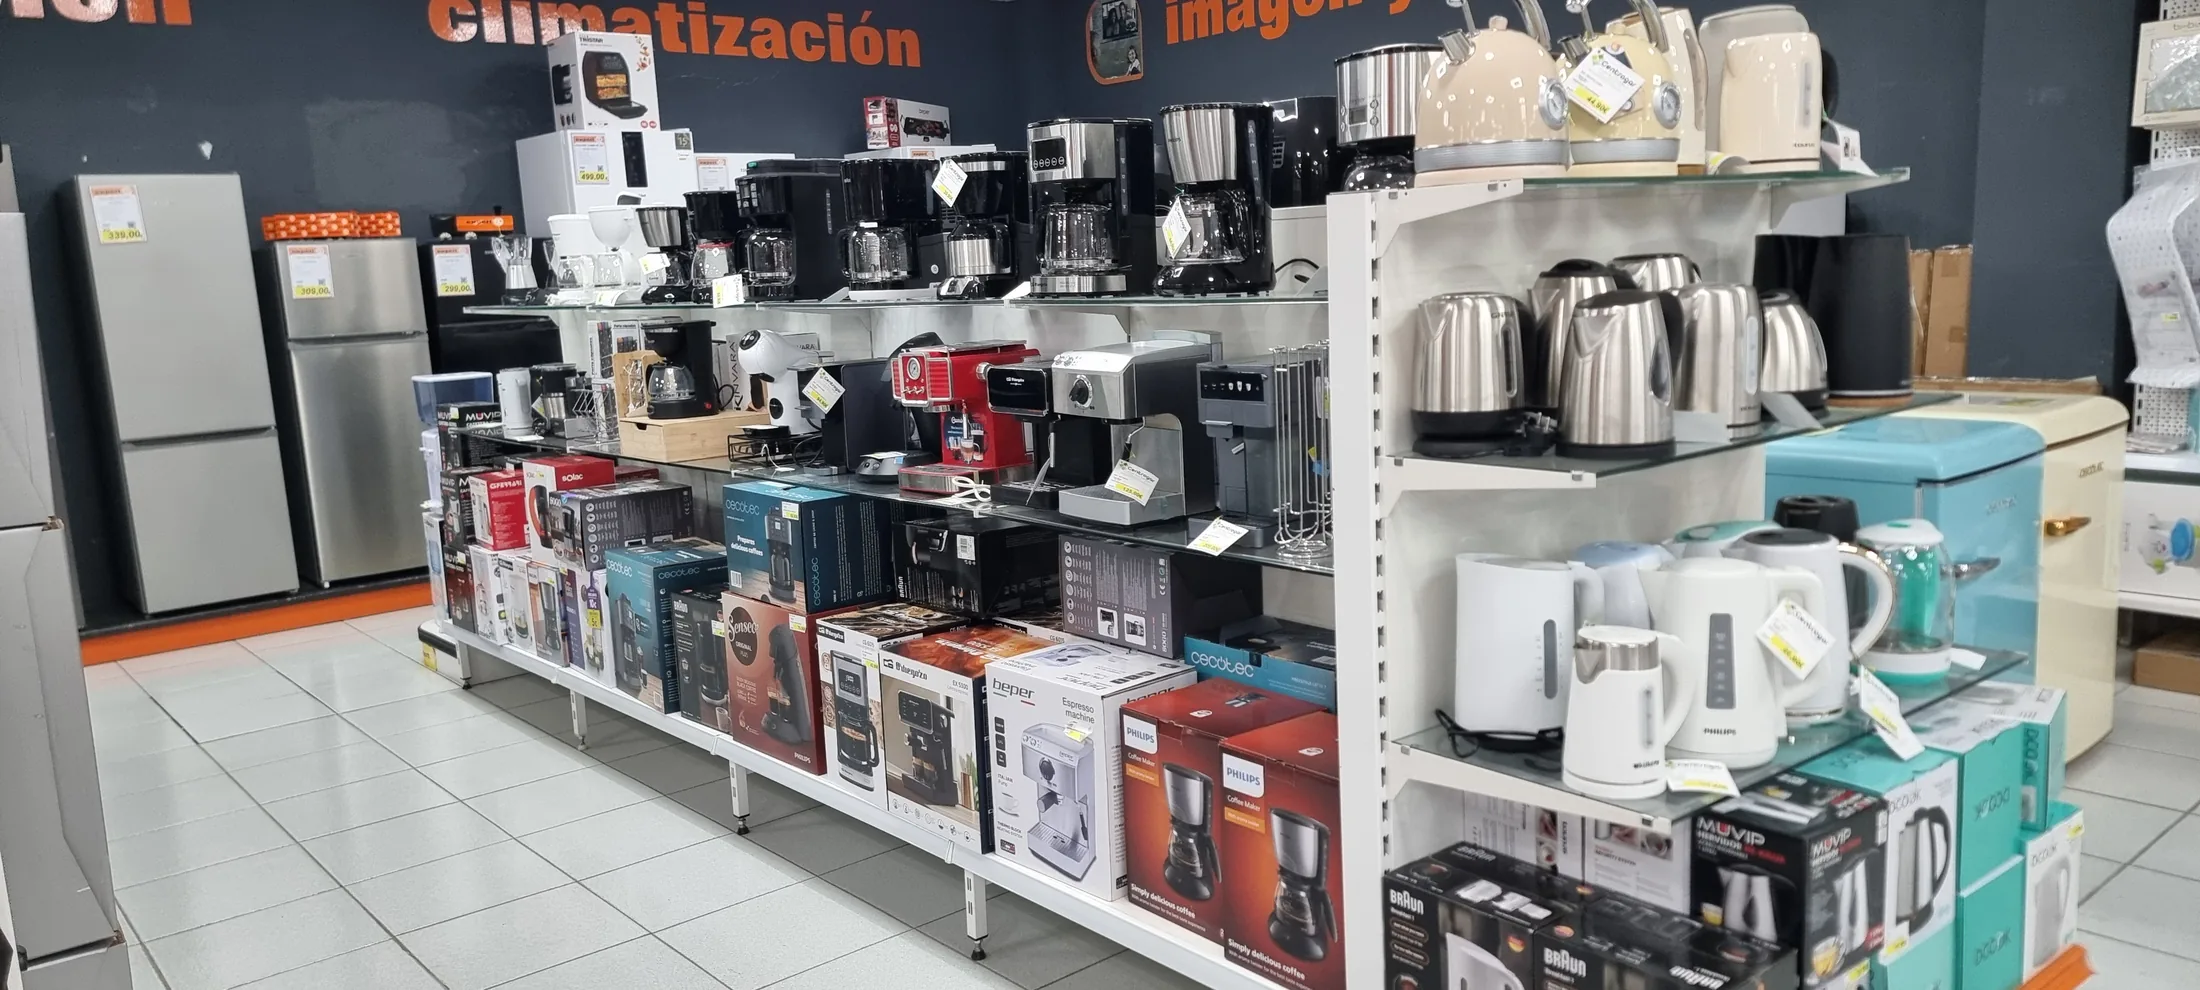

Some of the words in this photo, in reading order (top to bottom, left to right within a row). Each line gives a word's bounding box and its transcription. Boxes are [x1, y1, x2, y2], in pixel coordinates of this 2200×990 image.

[1191, 651, 1254, 678] cecotec
[993, 677, 1035, 699] beper
[1062, 697, 1094, 714] Espresso
[1065, 709, 1095, 724] machine
[1127, 727, 1155, 743] PHILIPS
[1128, 752, 1141, 761] Coffee
[1141, 757, 1155, 767] Maker
[1226, 767, 1260, 786] PHILIPS
[1227, 794, 1244, 806] Coffee
[1244, 801, 1260, 811] Maker
[1696, 816, 1766, 846] MUVIP
[1812, 827, 1852, 857] MUVIP
[1131, 883, 1150, 899] Simply
[1150, 892, 1176, 910] delicious
[1176, 904, 1196, 918] coffee
[1390, 889, 1424, 915] BRAUN
[1228, 938, 1251, 956] Simply
[1251, 949, 1281, 969] delicious
[1282, 963, 1306, 980] coffee
[1543, 947, 1587, 978] BRAUN
